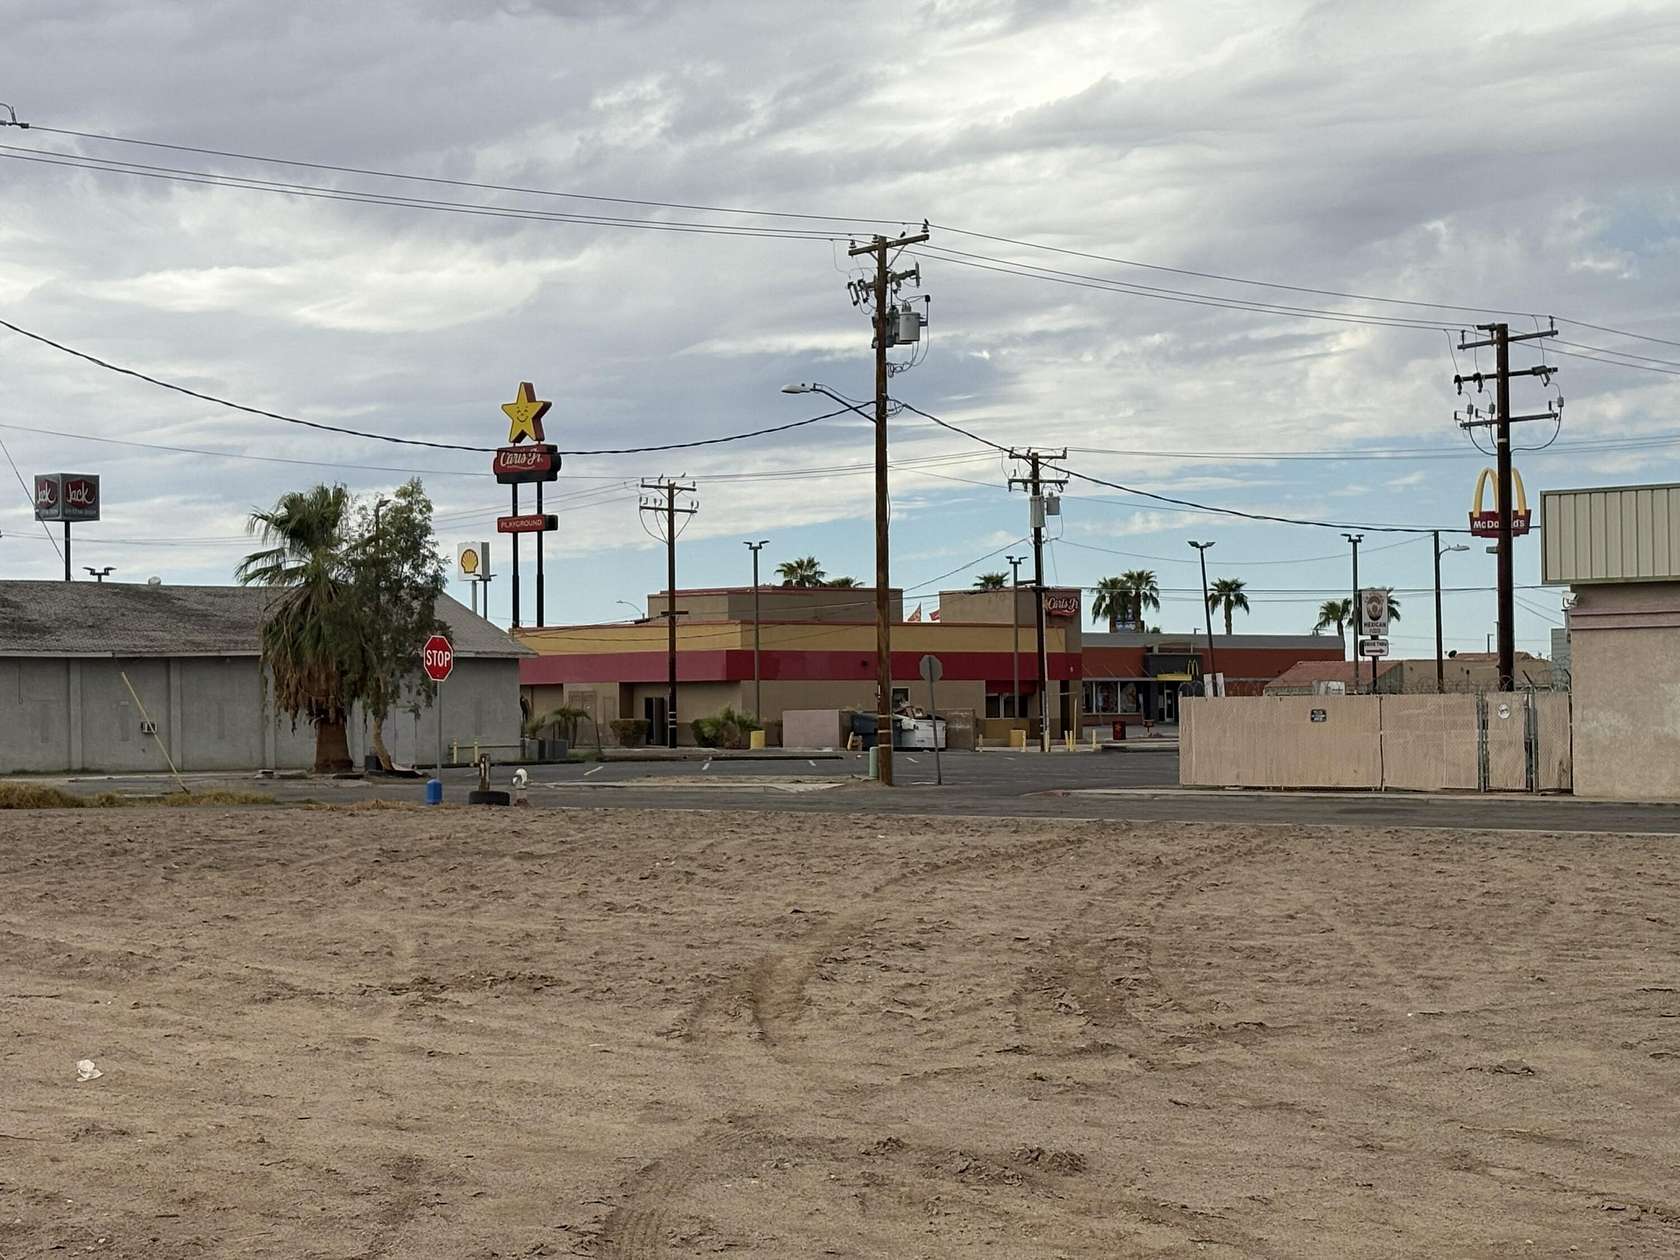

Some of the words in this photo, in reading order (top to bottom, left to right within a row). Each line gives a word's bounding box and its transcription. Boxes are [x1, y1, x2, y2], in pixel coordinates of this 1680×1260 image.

[37, 481, 57, 505] Jack
[66, 480, 96, 505] Jack
[500, 519, 543, 529] PLAYGROUND
[1473, 519, 1525, 529] McDod's
[426, 649, 451, 668] STOP
